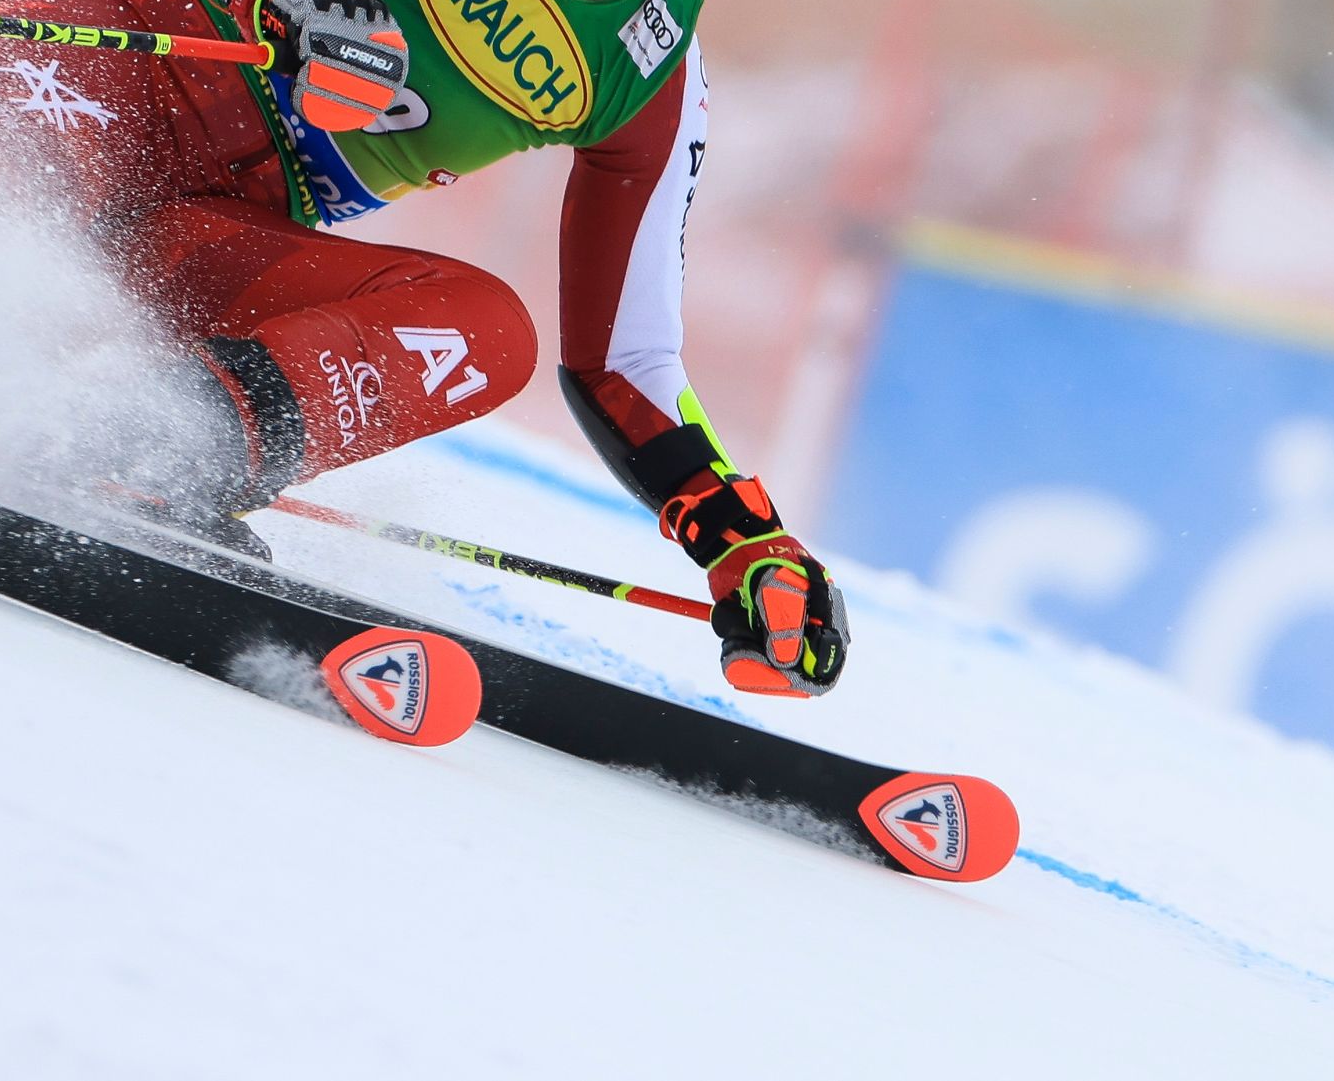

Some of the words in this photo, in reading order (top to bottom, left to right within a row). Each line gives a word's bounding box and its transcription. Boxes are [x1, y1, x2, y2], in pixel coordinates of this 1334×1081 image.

[33, 22, 129, 51] LEKI
[340, 44, 394, 71] reusch
[319, 350, 357, 449] UNIQA
[392, 327, 489, 407] A1
[401, 652, 420, 721] ROSSIGNOL
[942, 793, 959, 860] ROSSIGNOL
